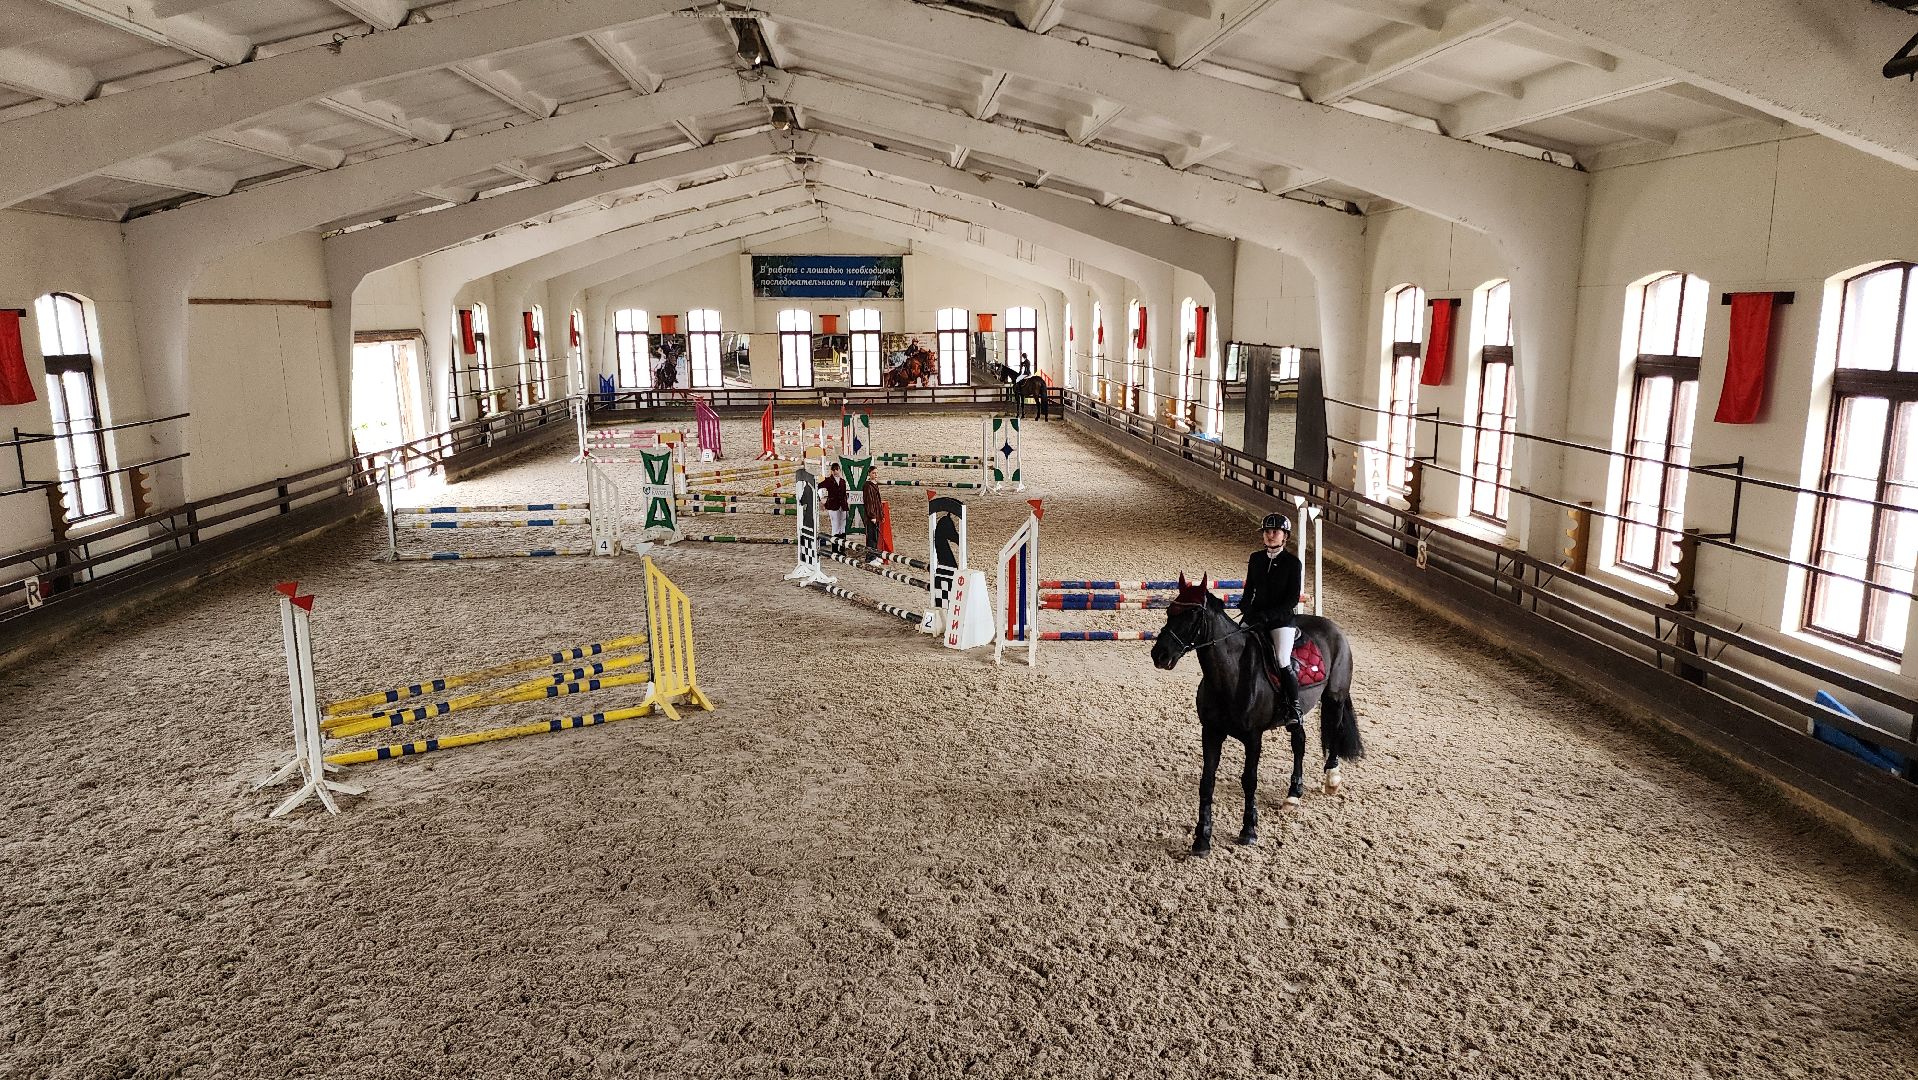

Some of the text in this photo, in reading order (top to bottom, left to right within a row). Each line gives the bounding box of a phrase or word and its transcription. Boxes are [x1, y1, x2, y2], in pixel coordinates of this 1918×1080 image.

[760, 265, 766, 274] В
[768, 265, 798, 275] работе
[806, 265, 844, 274] лошадью
[846, 265, 895, 275] необходимы
[760, 277, 846, 286] последовательность
[855, 279, 895, 288] терпение
[600, 540, 608, 551] 4
[27, 581, 42, 606] R
[948, 575, 965, 646] ФИНИШ
[924, 615, 933, 628] 2
